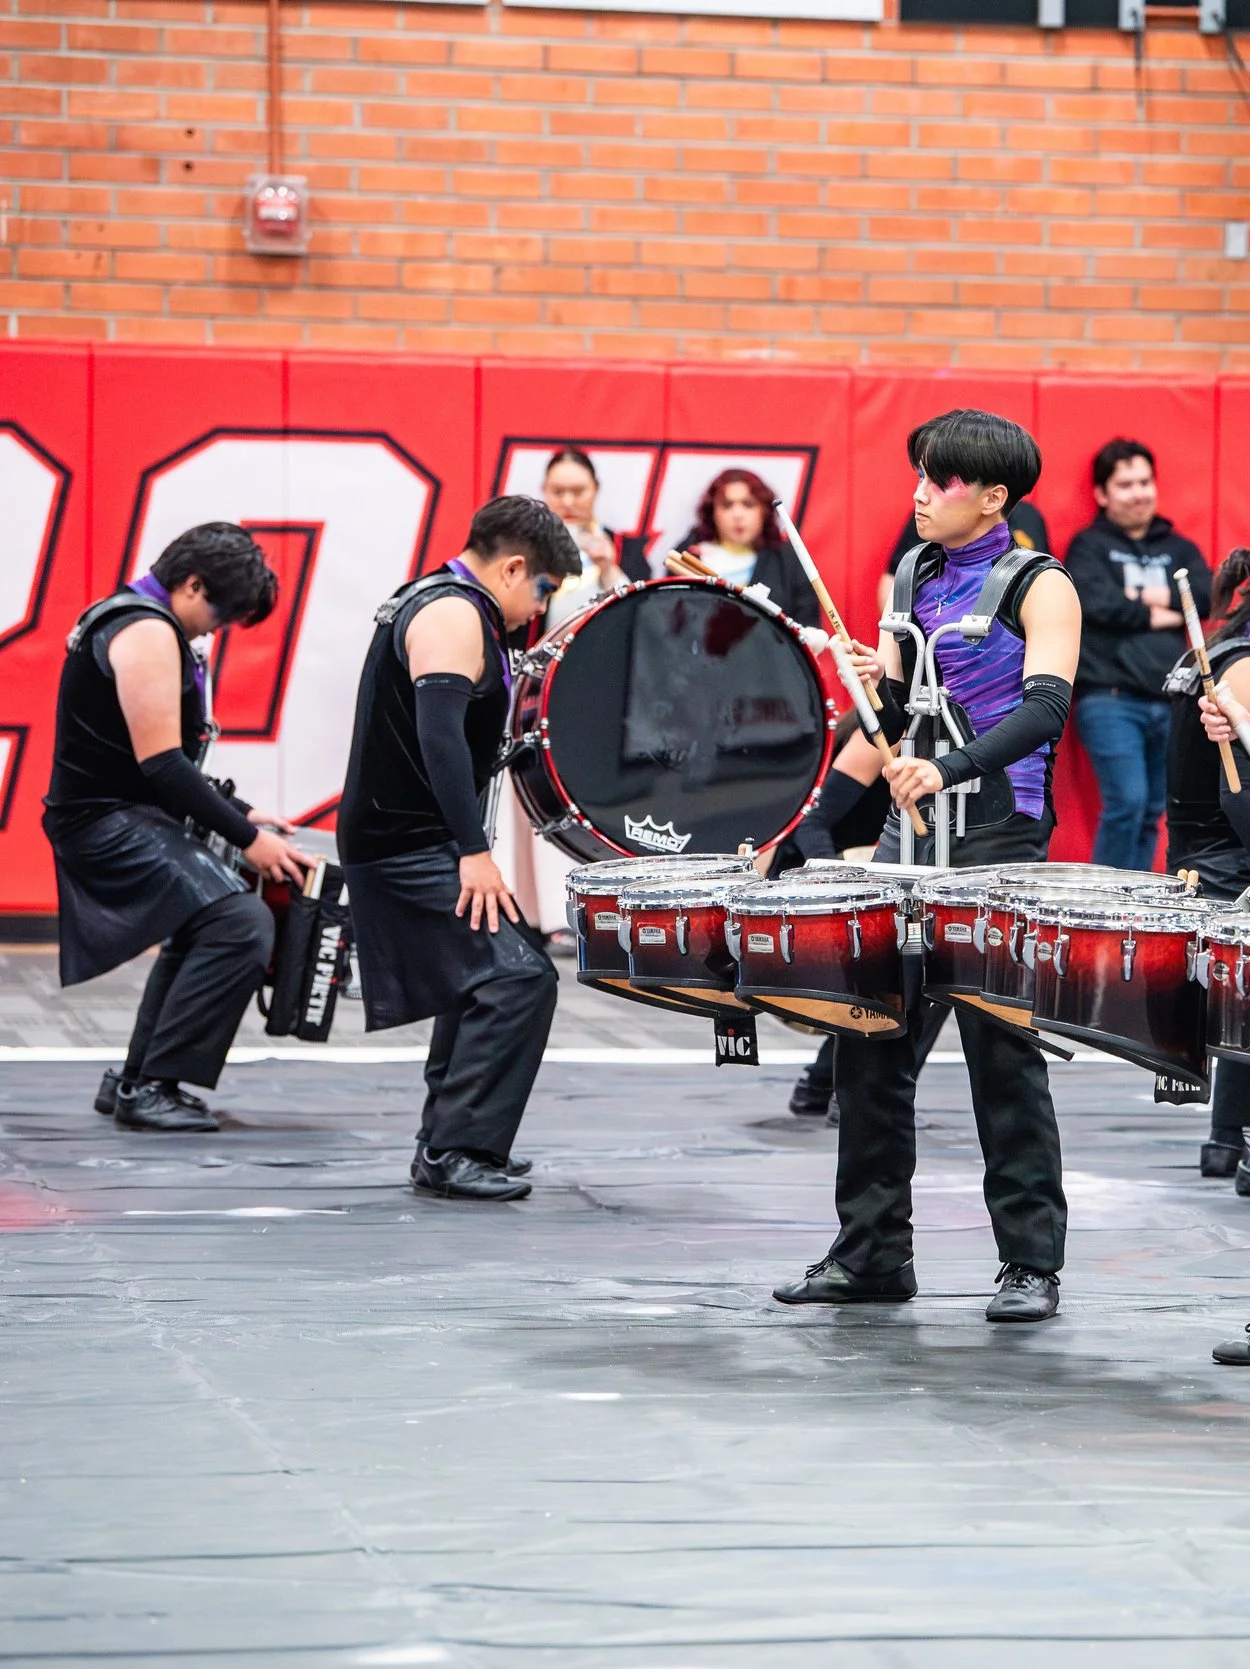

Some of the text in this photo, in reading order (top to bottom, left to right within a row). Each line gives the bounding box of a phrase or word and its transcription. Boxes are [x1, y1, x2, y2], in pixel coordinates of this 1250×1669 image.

[630, 826, 682, 848] REMO
[318, 925, 344, 961] VIC
[717, 1028, 750, 1057] VIC
